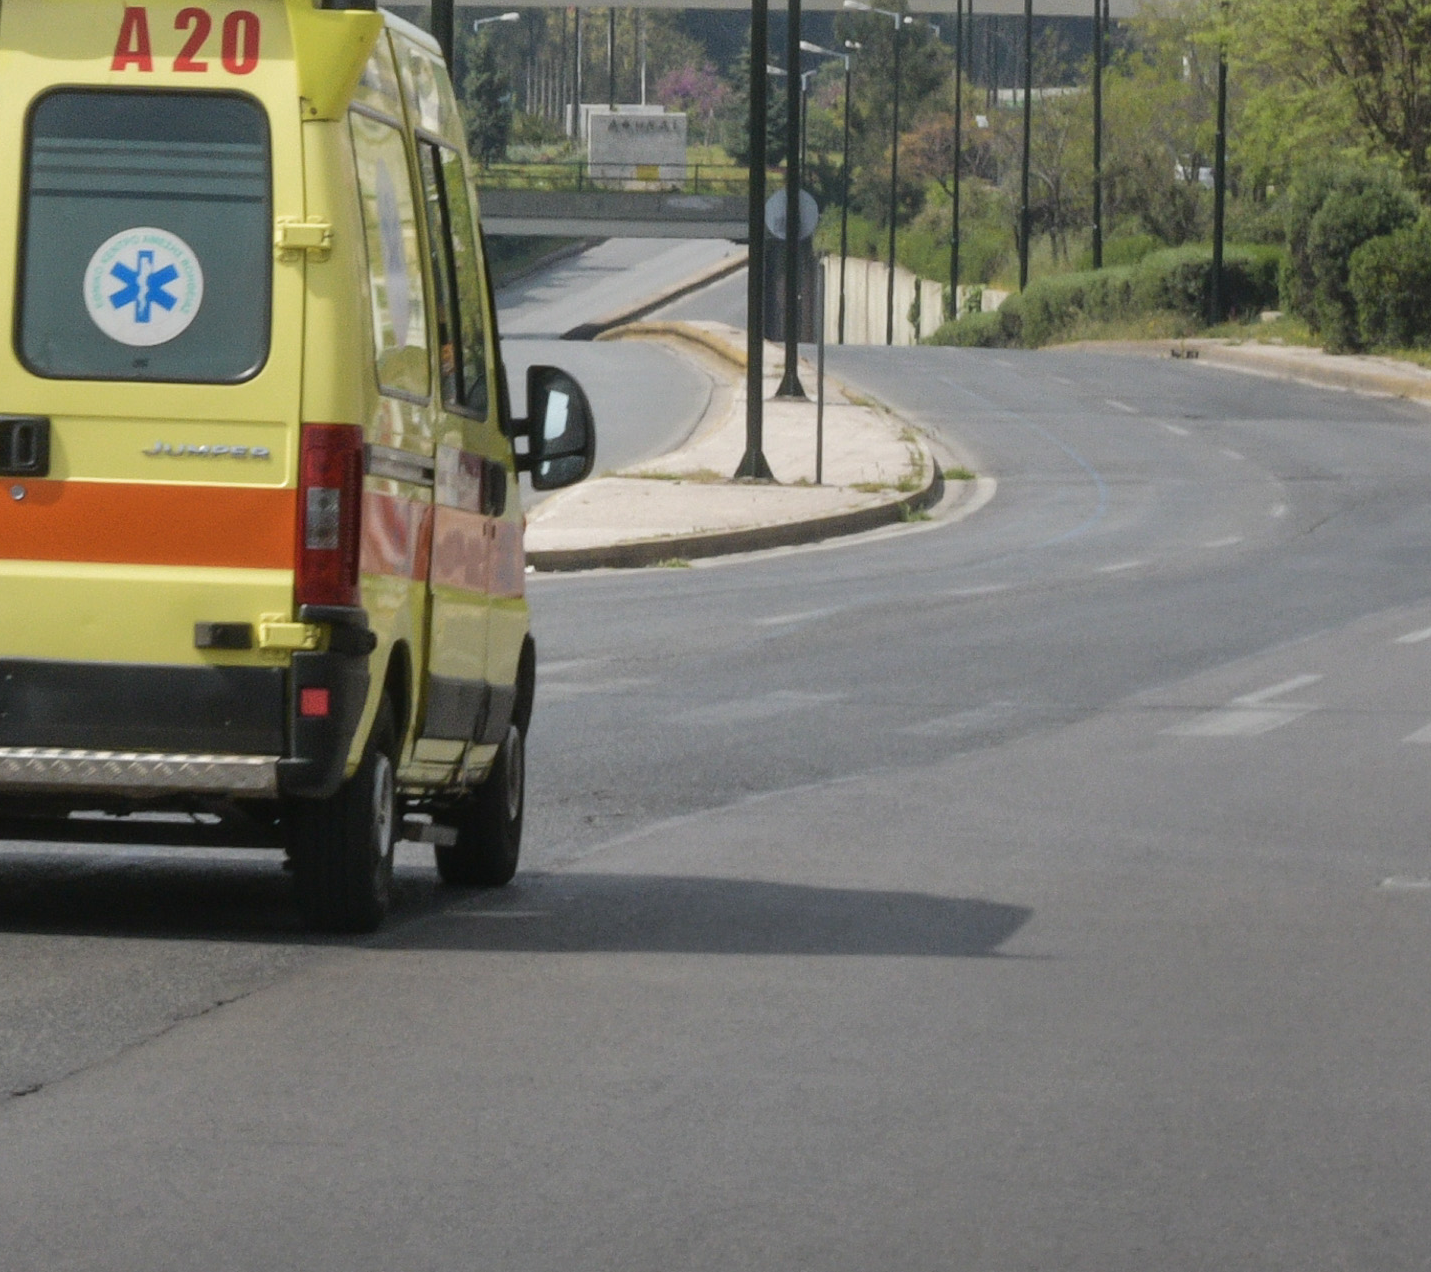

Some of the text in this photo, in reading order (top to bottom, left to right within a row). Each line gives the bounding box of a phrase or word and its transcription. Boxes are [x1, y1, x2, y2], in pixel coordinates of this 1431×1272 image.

[110, 5, 260, 75] A 20
[143, 441, 270, 459] JUMPER
